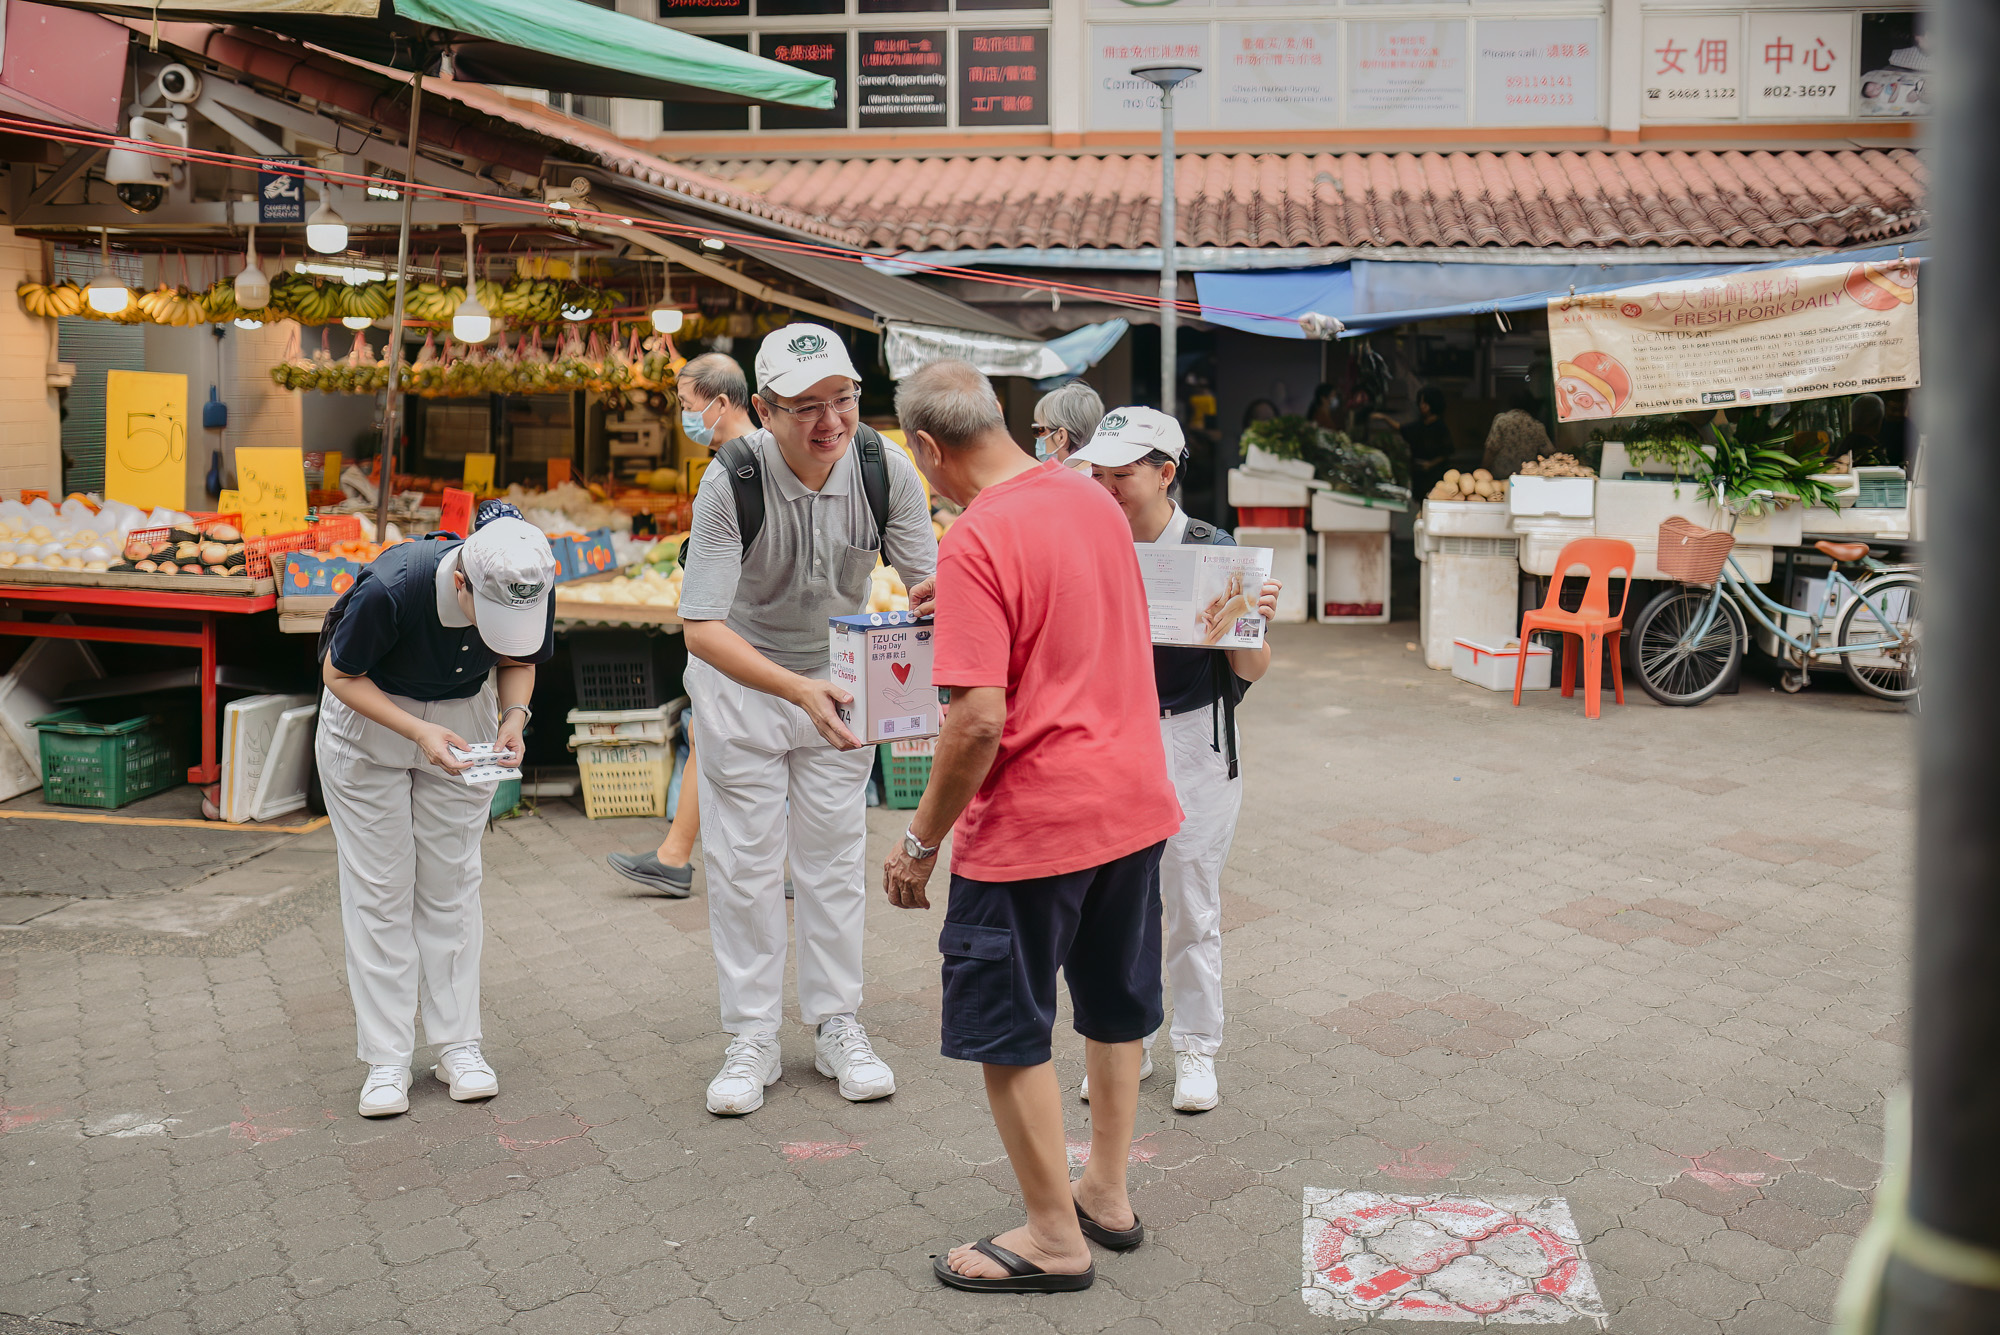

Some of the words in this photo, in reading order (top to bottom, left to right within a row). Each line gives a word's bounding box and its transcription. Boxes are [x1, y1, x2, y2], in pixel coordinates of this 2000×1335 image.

[1656, 38, 1728, 75] 女佣
[1764, 37, 1836, 74] 中心
[1764, 85, 1836, 98] #02-3697
[1674, 309, 1731, 326] FRESH
[1737, 302, 1788, 321] PORK
[1791, 289, 1844, 312] DAILY
[1819, 324, 1861, 334] SINGAPORE
[1631, 330, 1672, 343] LOCATE
[1677, 331, 1692, 340] US
[797, 355, 812, 363] TZU
[1635, 399, 1671, 408] FOLLOW
[871, 634, 889, 643] TZU
[892, 632, 907, 641] CHI
[873, 643, 887, 651] Flag
[889, 642, 902, 650] Day
[838, 669, 857, 683] Change
